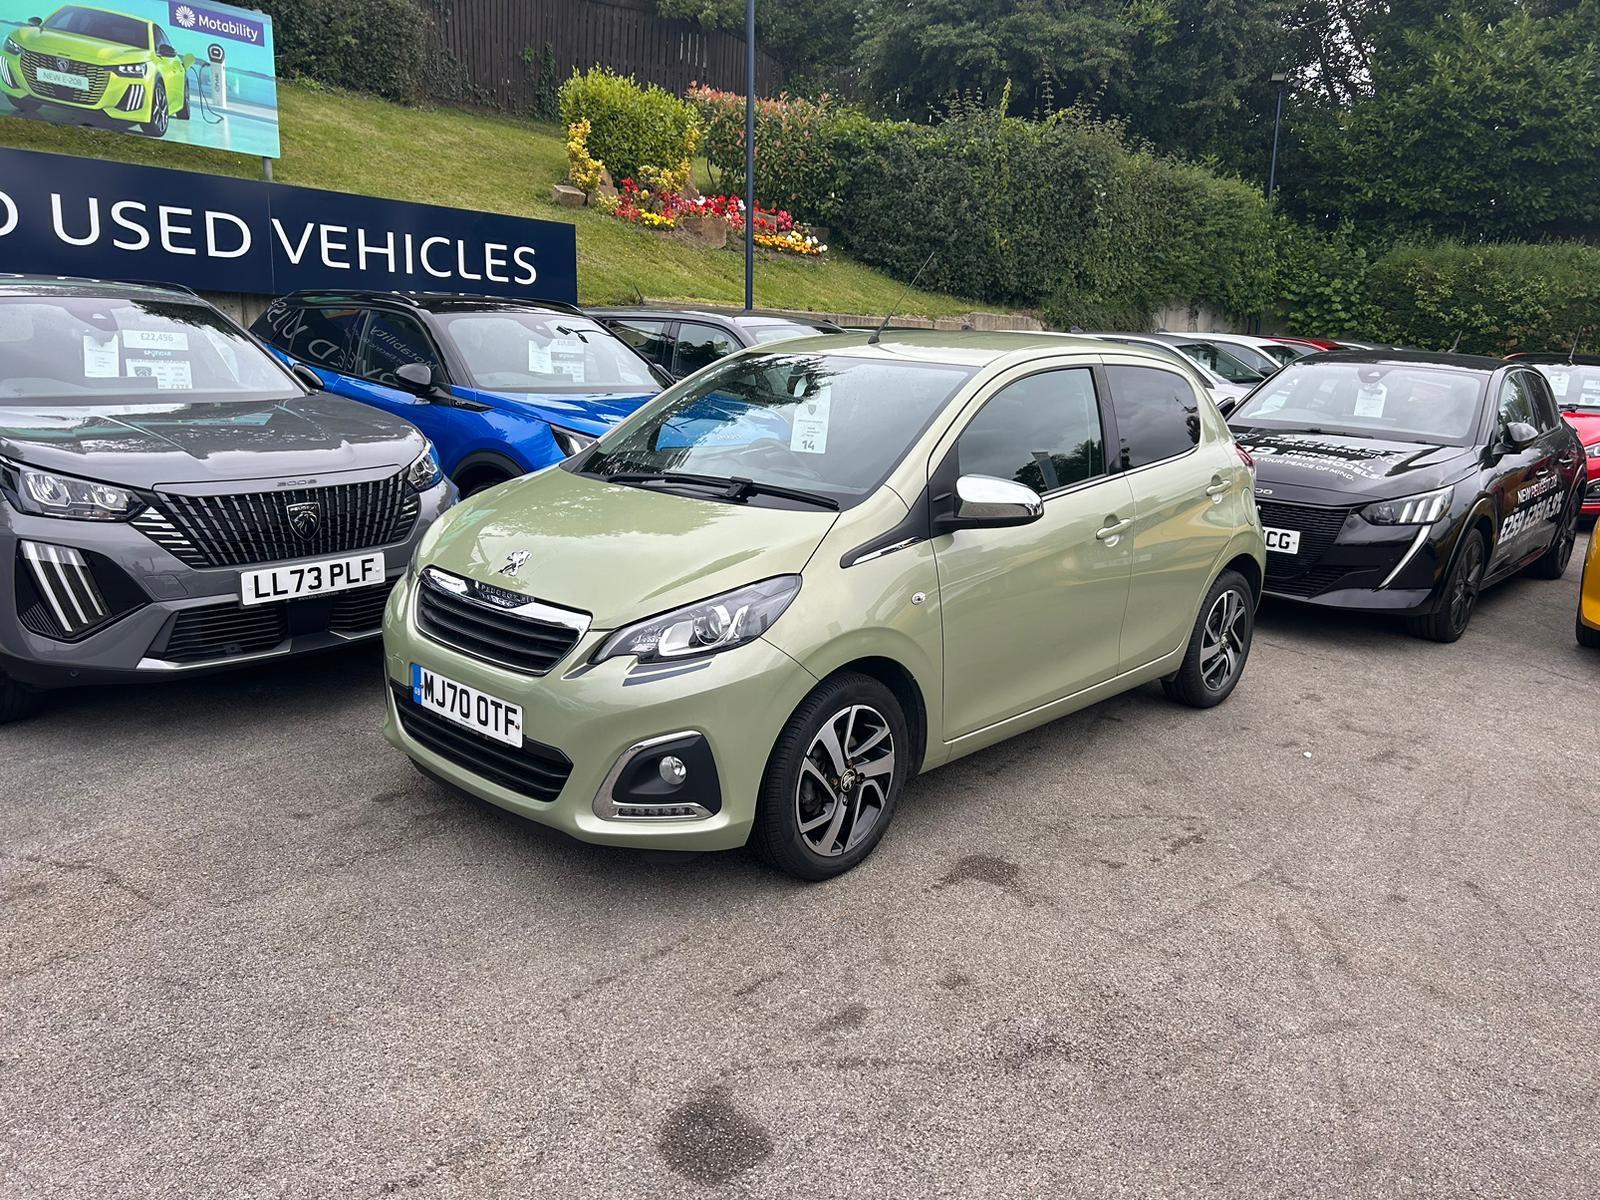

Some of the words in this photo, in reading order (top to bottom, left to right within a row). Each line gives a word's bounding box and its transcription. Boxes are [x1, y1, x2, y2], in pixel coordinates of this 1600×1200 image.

[198, 14, 258, 42] Motability
[50, 192, 253, 259] USED
[271, 217, 537, 285] VEHICLES
[802, 440, 815, 450] 14
[1260, 457, 1286, 465] YOUR
[1286, 459, 1315, 470] PEACE
[1316, 465, 1331, 473] OF
[1351, 459, 1376, 472] ALL
[1517, 486, 1531, 504] NEW
[253, 566, 322, 598] LL73
[329, 558, 375, 587] PLF
[424, 671, 470, 719] MJ70
[477, 695, 518, 736] OTF
